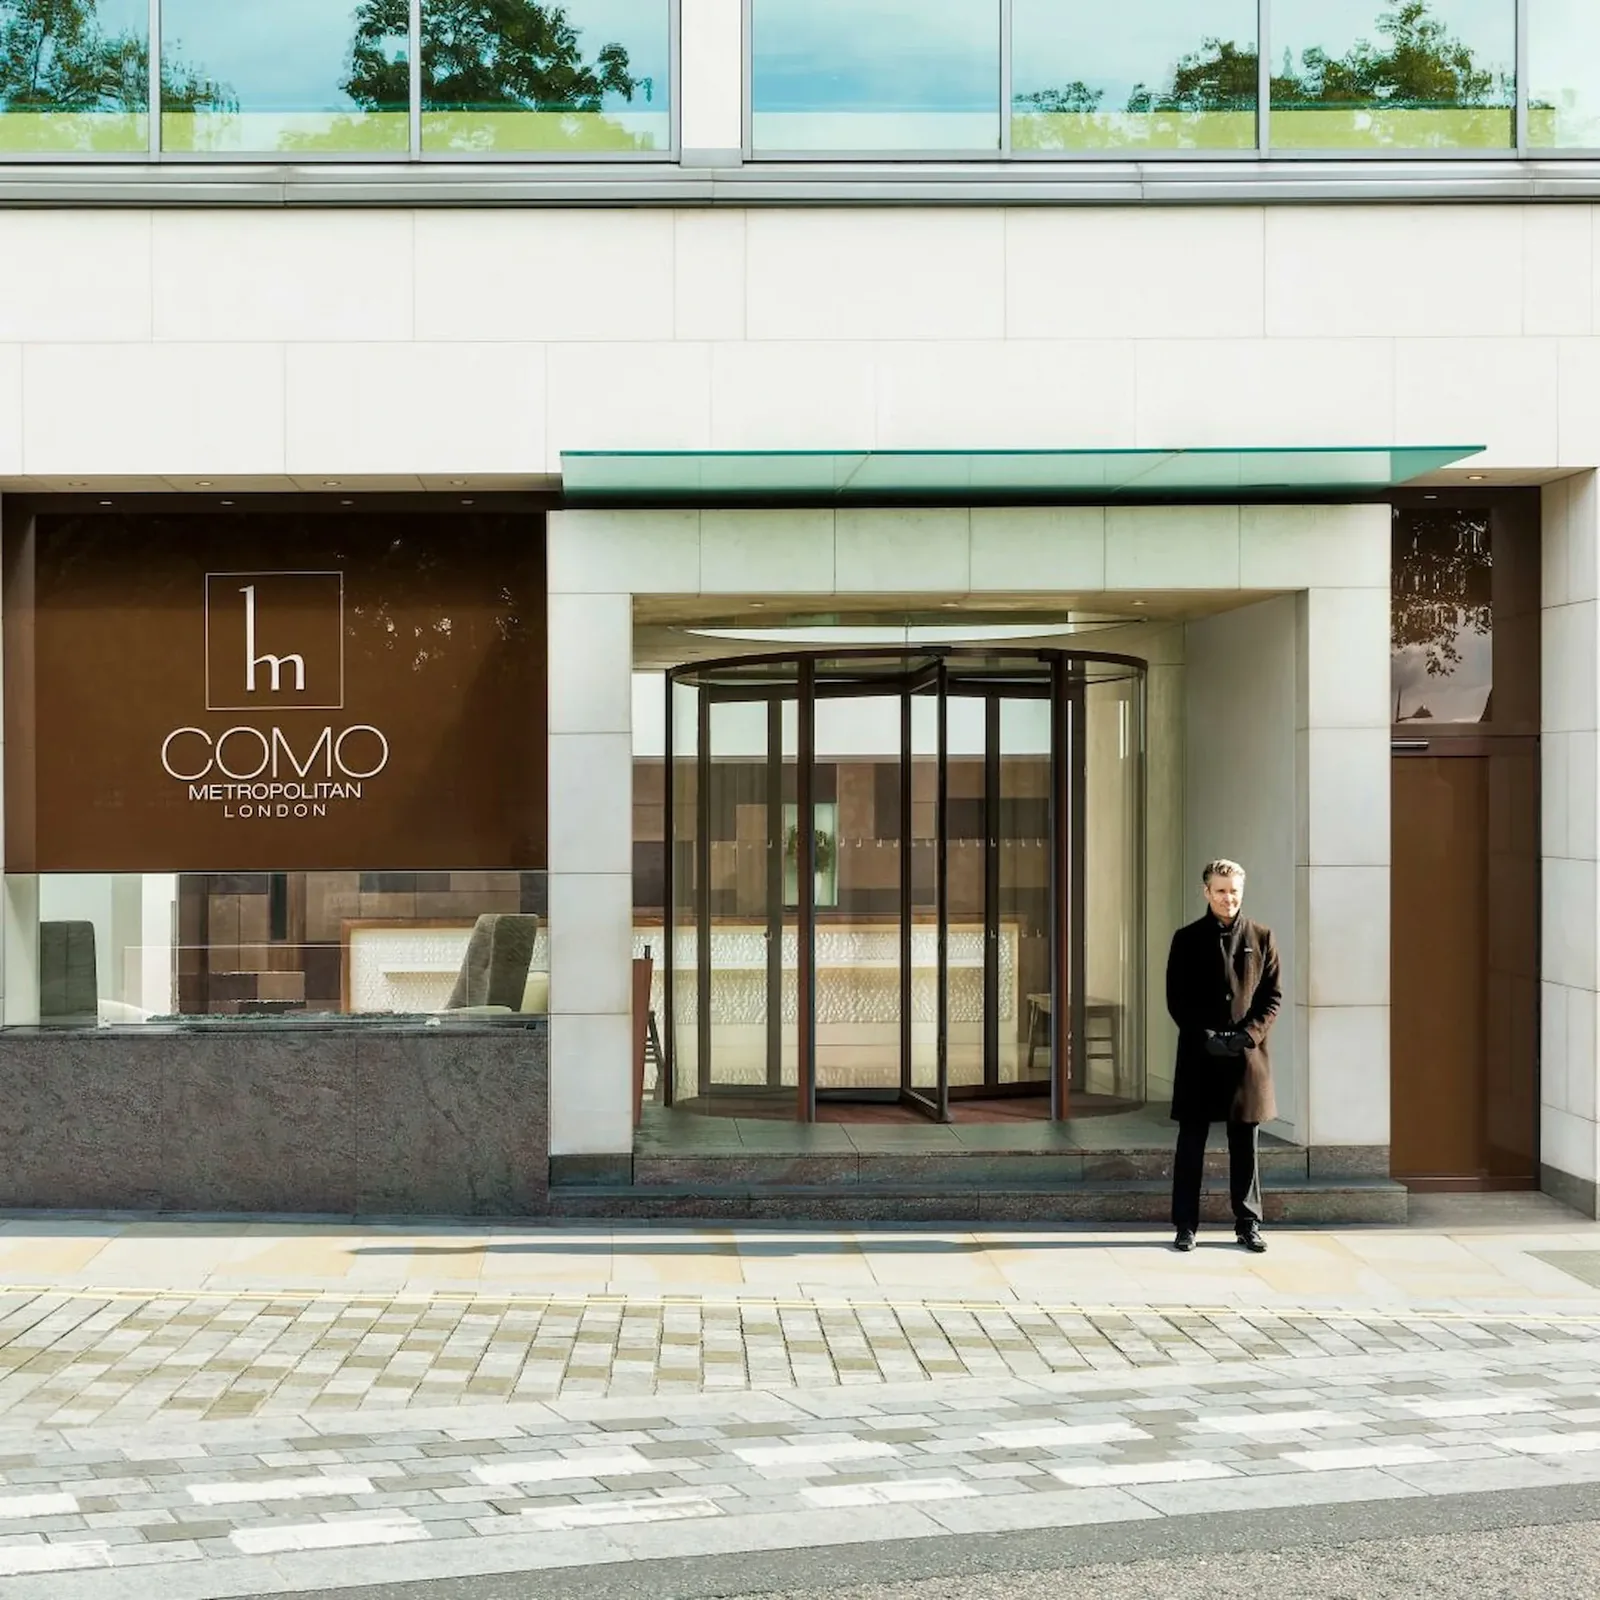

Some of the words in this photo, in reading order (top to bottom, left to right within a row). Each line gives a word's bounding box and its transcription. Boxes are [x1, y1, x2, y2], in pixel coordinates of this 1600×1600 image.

[161, 724, 389, 780] COMO
[188, 782, 361, 801] METROPOLITAN
[224, 803, 326, 818] LONDON
